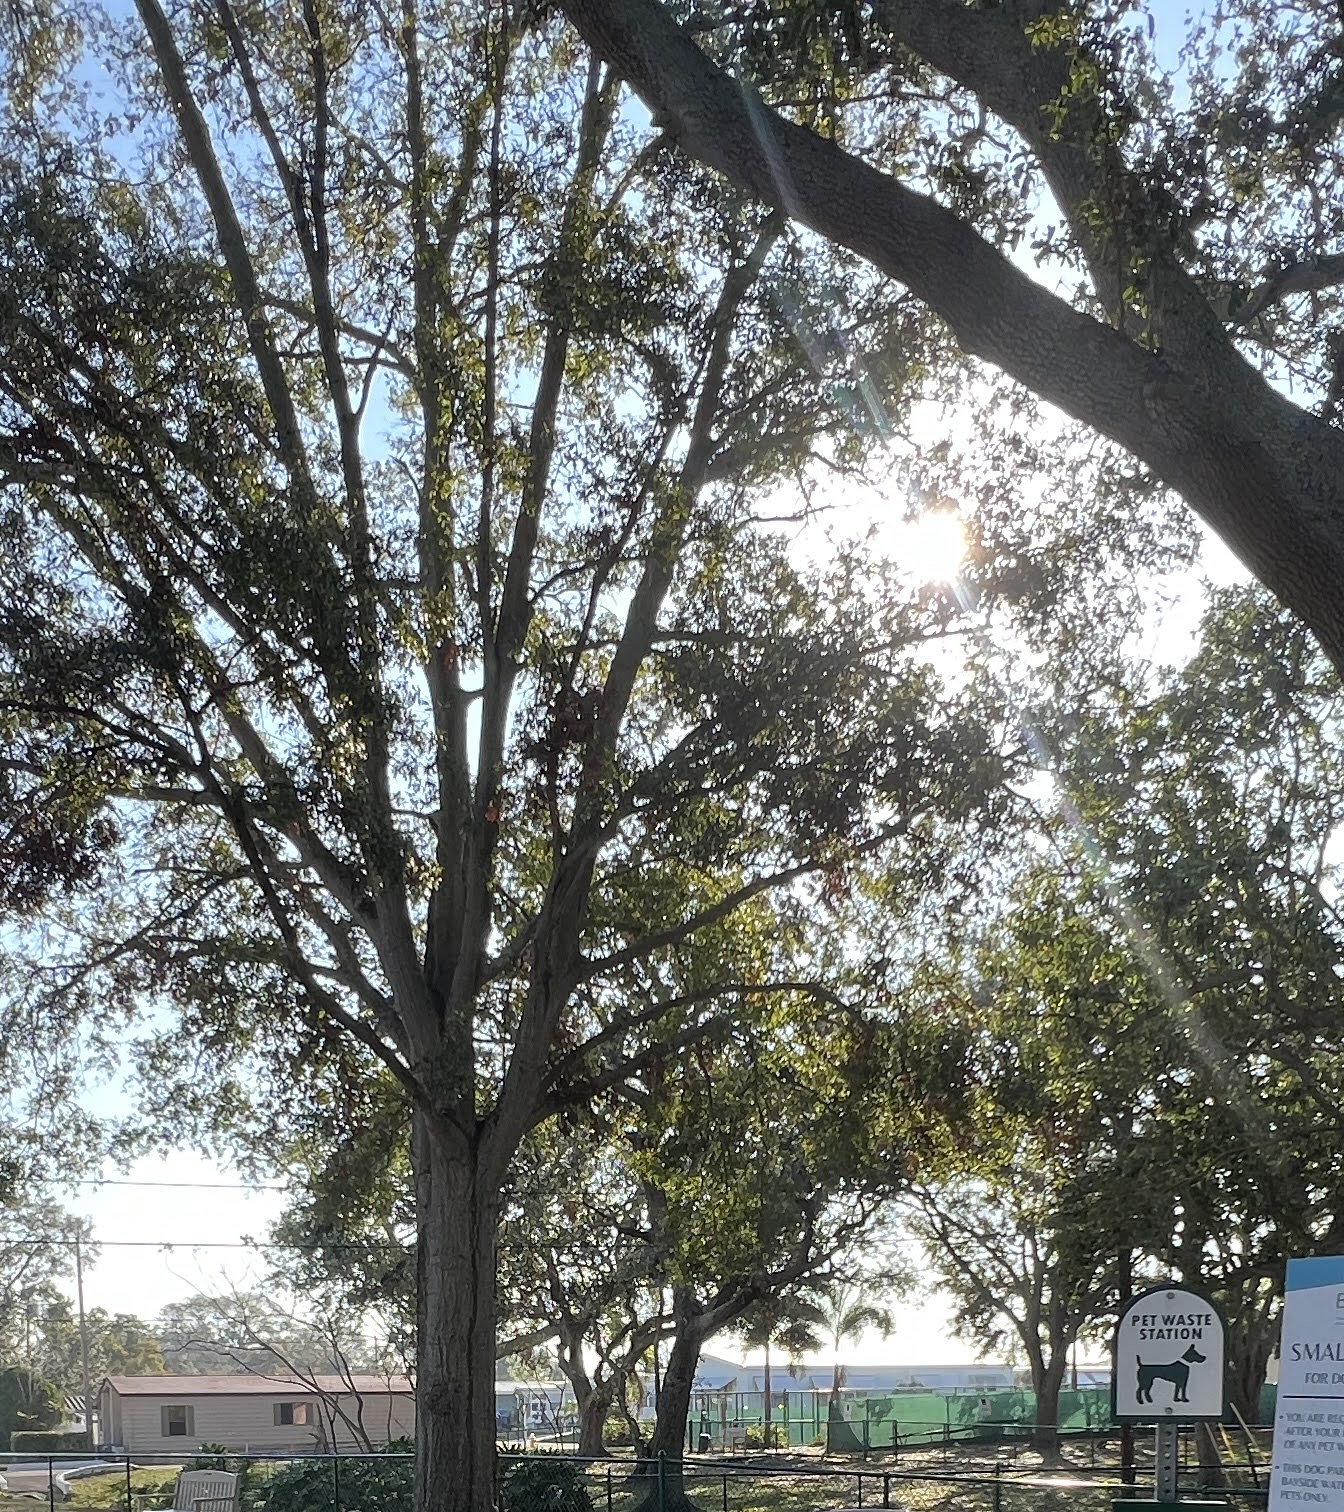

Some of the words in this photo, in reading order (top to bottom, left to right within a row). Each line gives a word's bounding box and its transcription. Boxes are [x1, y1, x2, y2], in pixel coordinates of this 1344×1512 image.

[1132, 1315, 1157, 1326] PET
[1162, 1314, 1212, 1326] WASTE
[1140, 1328, 1202, 1340] STATION
[1305, 1373, 1328, 1384] FOR
[1285, 1413, 1305, 1423] YOU
[1307, 1414, 1324, 1423] ARE
[1284, 1427, 1312, 1436] AFTER
[1315, 1428, 1340, 1437] YOUR
[1284, 1440, 1296, 1449] OF
[1298, 1441, 1316, 1450] ANY
[1318, 1441, 1335, 1450] PET
[1283, 1463, 1302, 1473] THIS
[1304, 1465, 1325, 1474] DOG
[1281, 1477, 1319, 1488] BAYSIDE
[1280, 1491, 1301, 1500] PETS
